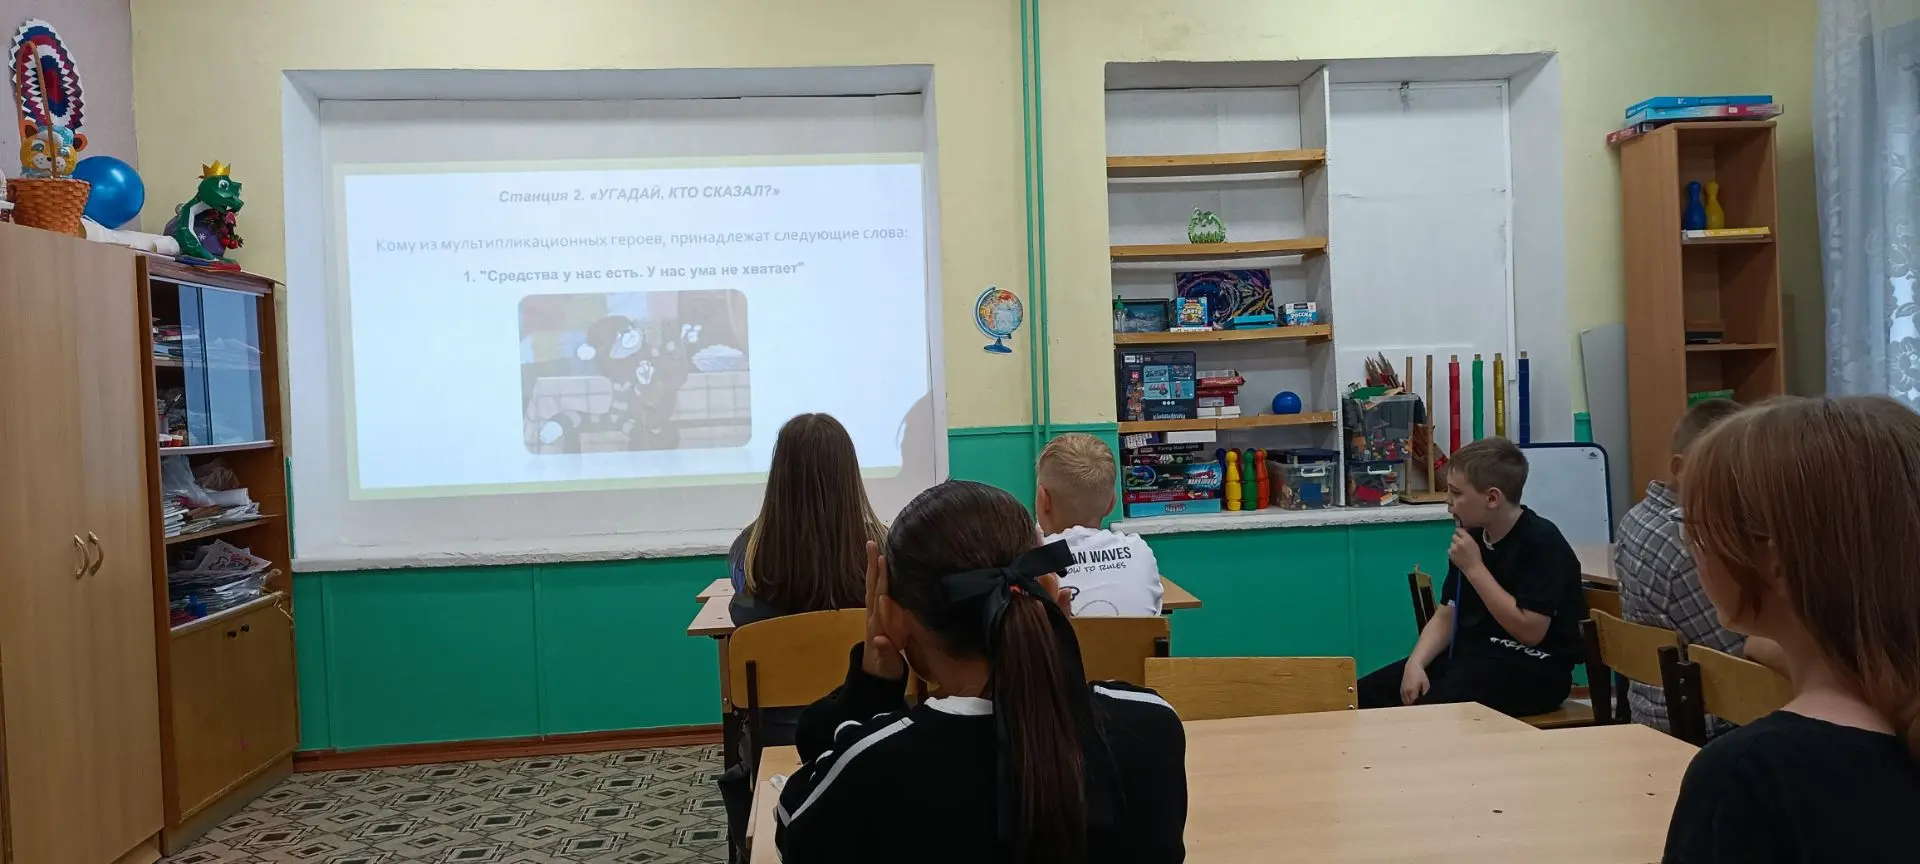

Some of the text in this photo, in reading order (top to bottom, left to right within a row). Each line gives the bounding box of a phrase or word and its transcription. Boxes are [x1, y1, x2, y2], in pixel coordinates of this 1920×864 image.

[499, 184, 780, 205] Станция 2. «УГАДАЙ, КТО СКАЗАЛ?»
[376, 228, 908, 254] Кому из мультипликационных героев, принадлежат следующие слова:
[463, 270, 476, 283] 1.
[480, 269, 559, 284] "Средства
[563, 270, 571, 283] у
[576, 270, 601, 280] нас
[606, 268, 642, 279] есть.
[660, 267, 685, 277] нас
[690, 266, 716, 279] ума
[722, 265, 737, 276] не
[742, 261, 804, 275] хватает"
[1089, 546, 1132, 563] WAVES
[1099, 561, 1127, 572] RULES
